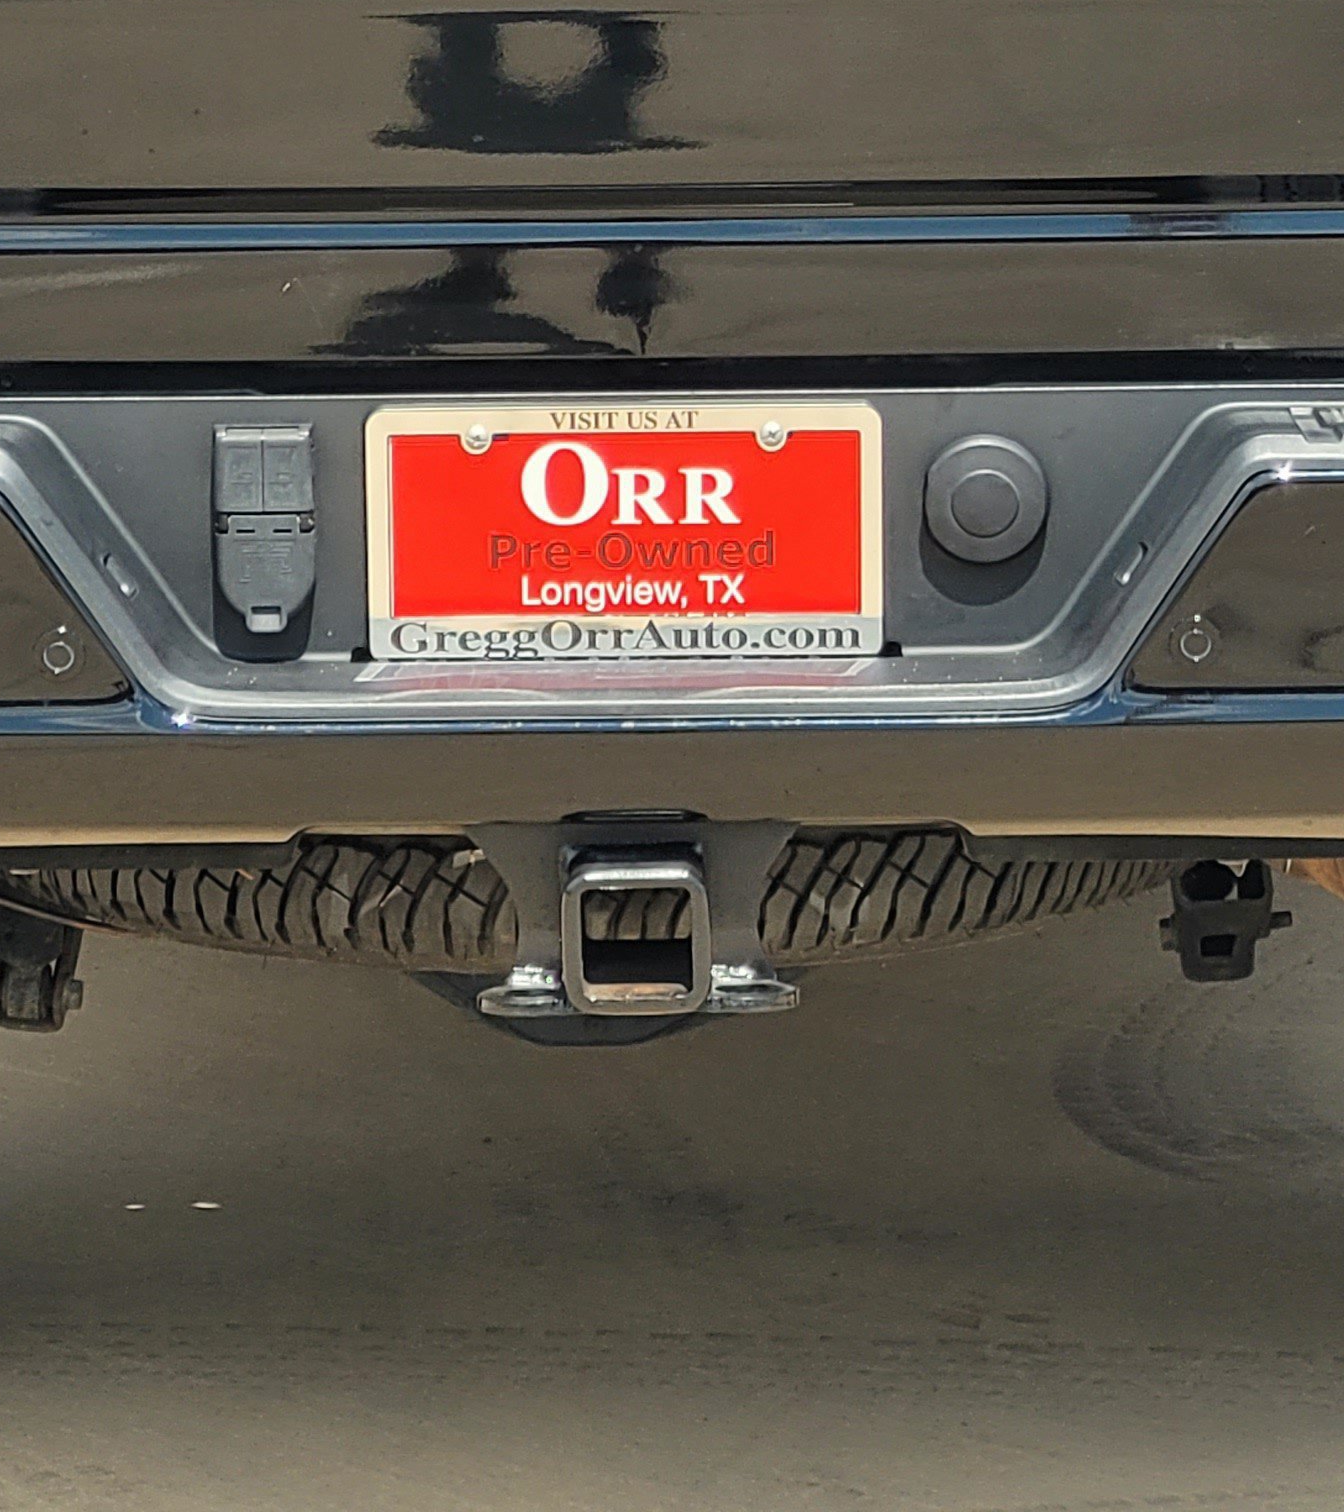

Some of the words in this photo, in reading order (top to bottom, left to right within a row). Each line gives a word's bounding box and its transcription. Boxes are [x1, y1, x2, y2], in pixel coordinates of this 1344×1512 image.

[550, 412, 619, 430] VISIT
[626, 412, 658, 430] US
[665, 411, 699, 429] AT
[488, 530, 776, 570] Pre-Owned
[521, 574, 689, 612] Longview,
[698, 573, 746, 605] TX
[390, 619, 861, 659] GreggOrrAuto.com
